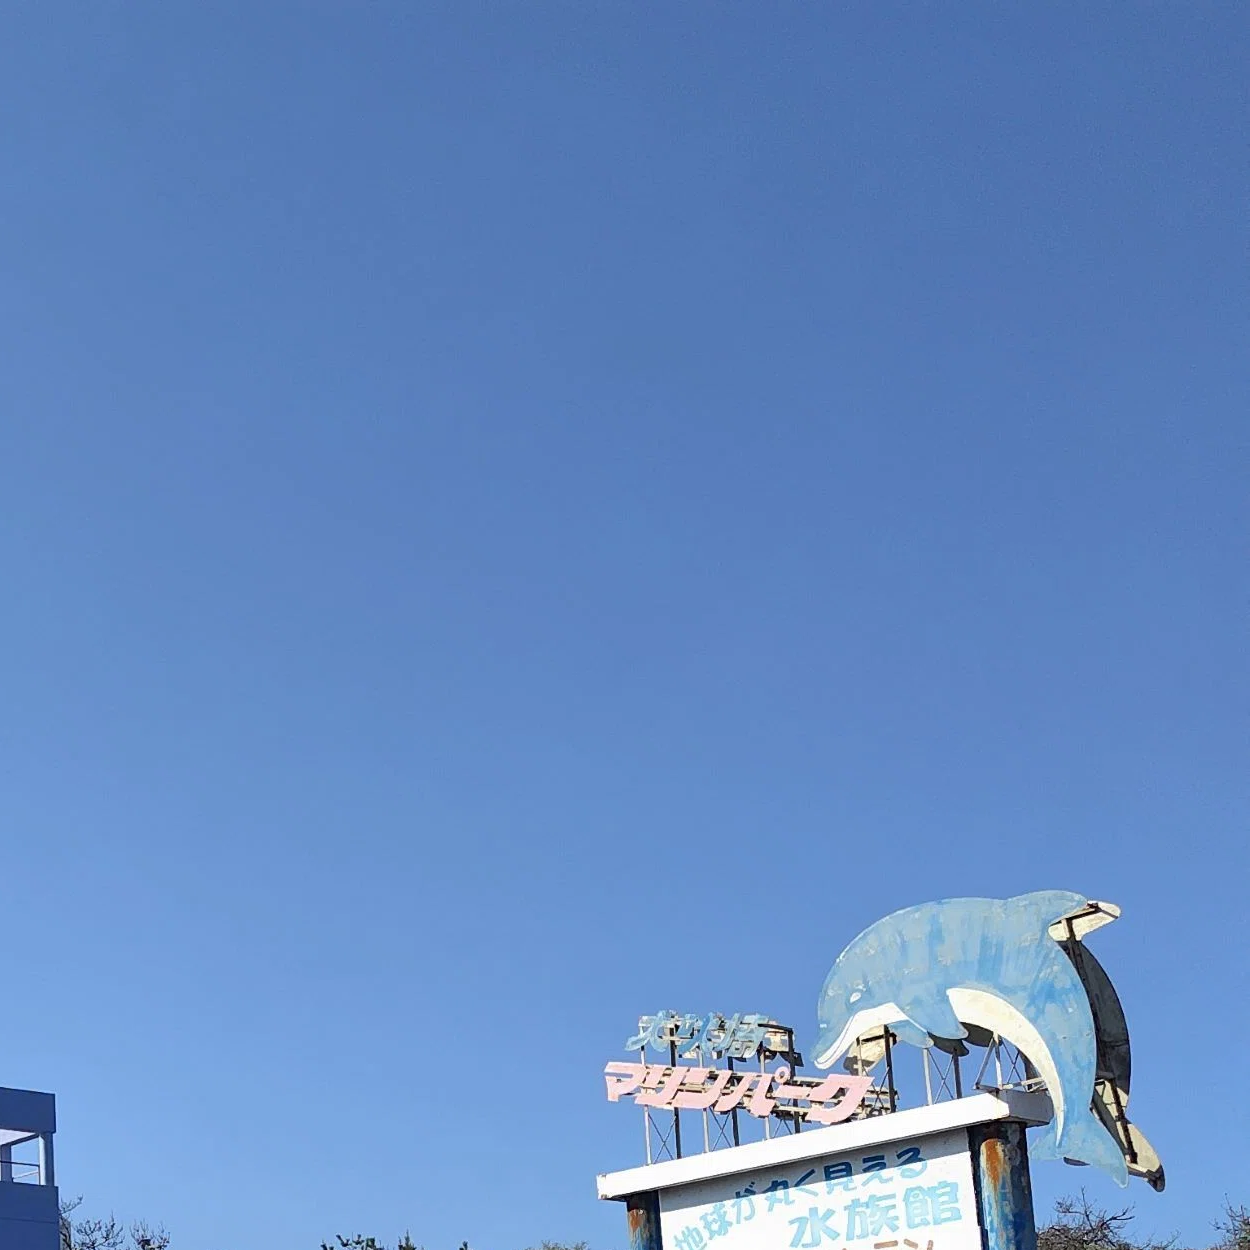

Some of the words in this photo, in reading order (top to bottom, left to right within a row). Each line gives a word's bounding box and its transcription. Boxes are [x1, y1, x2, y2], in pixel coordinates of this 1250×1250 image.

[605, 1061, 875, 1125] マリンパーク
[789, 1180, 962, 1248] 水族館
